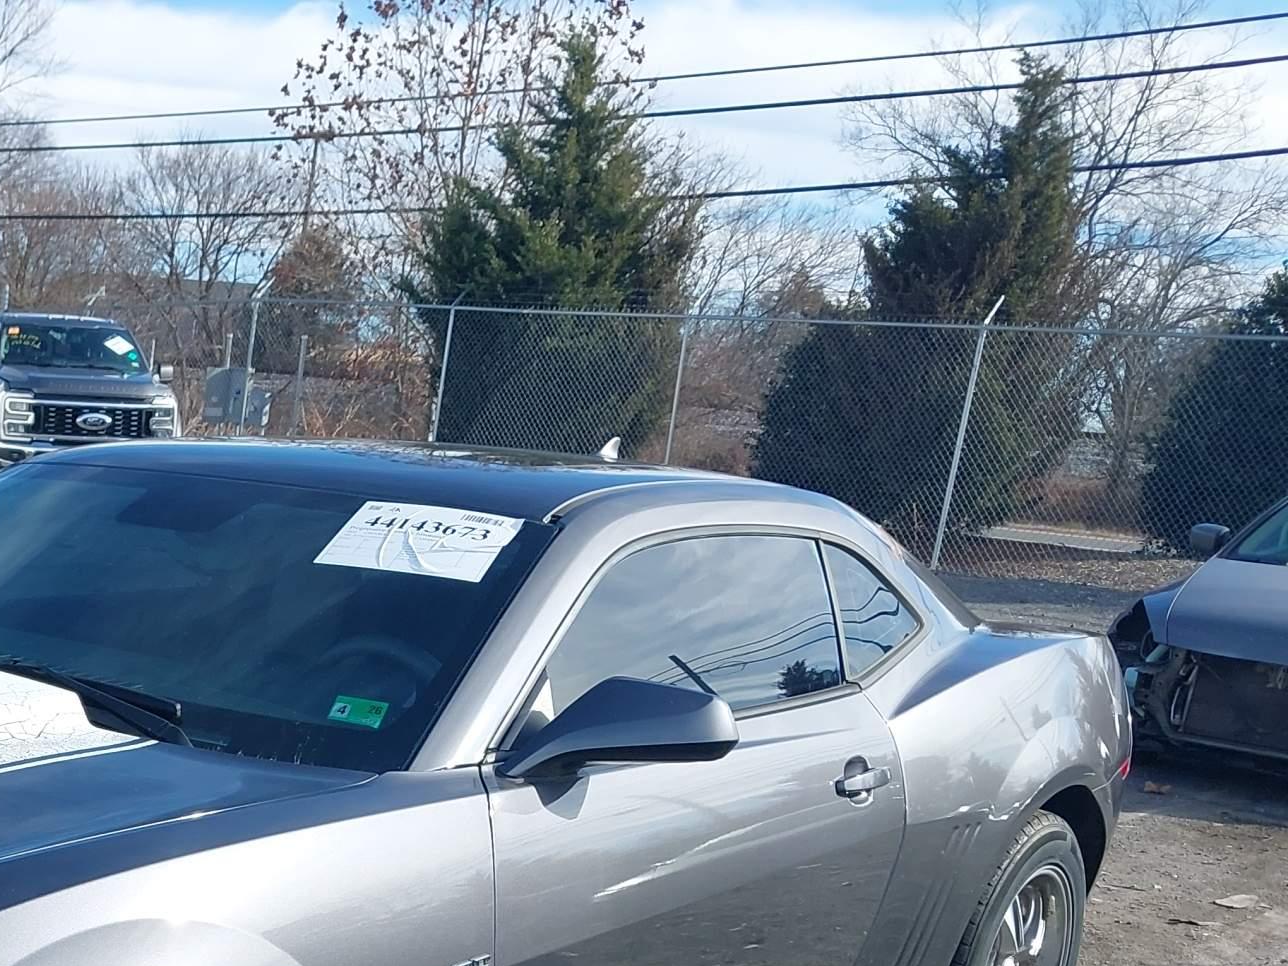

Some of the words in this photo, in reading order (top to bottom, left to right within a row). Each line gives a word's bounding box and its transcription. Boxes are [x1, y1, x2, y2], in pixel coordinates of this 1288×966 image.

[365, 516, 490, 541] 44143673
[337, 704, 348, 715] 4
[368, 704, 384, 715] 26
